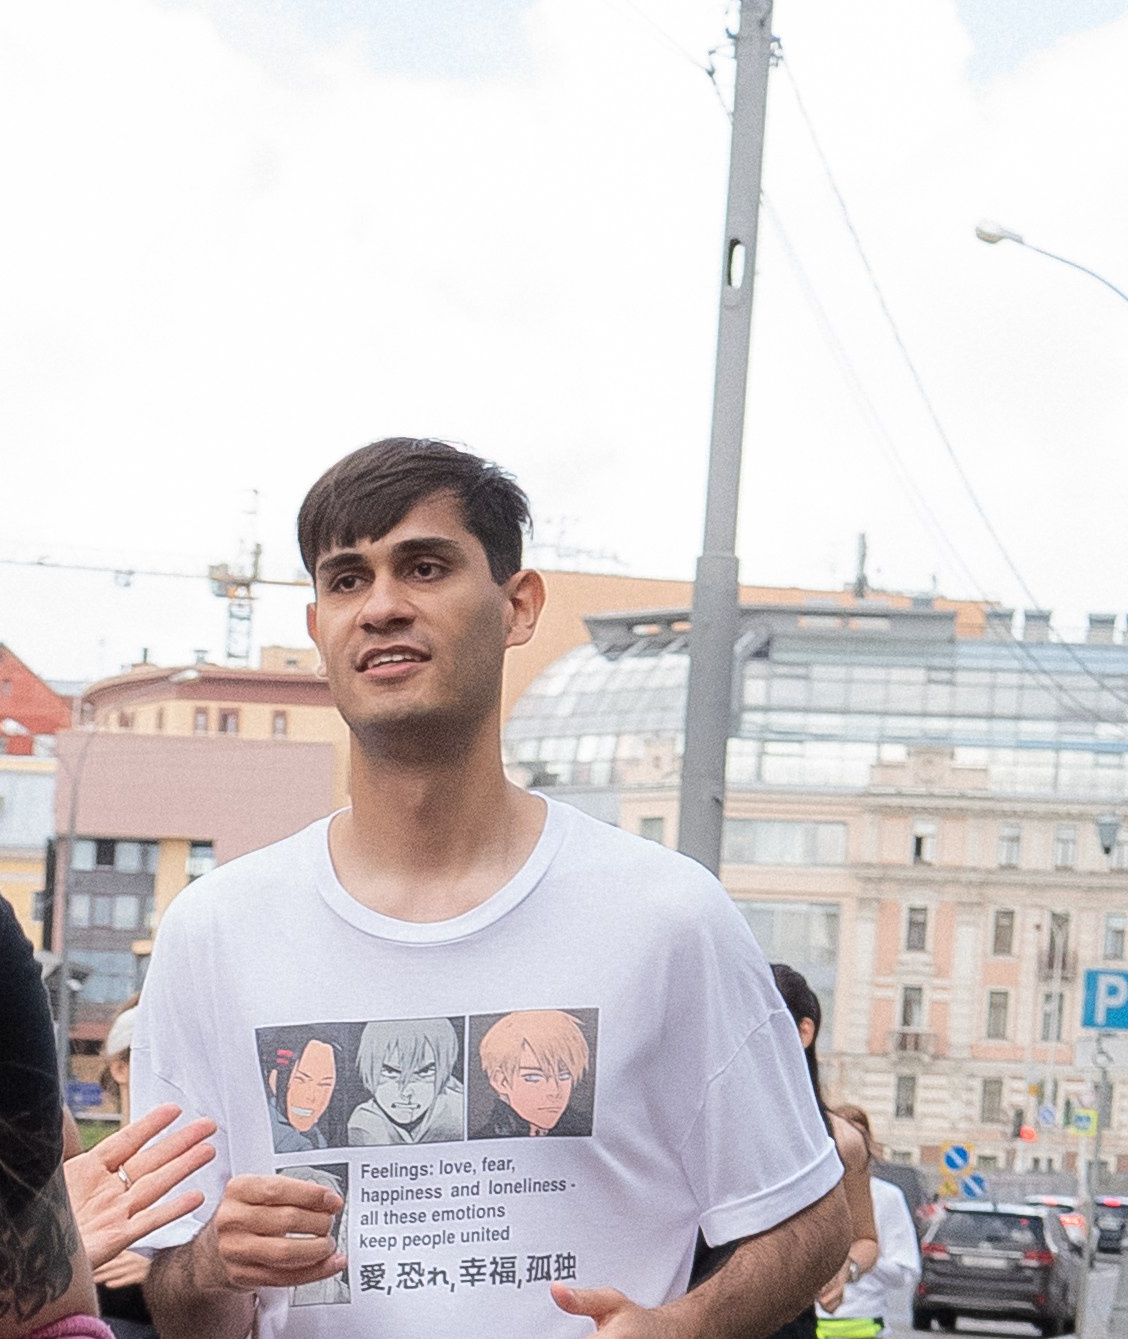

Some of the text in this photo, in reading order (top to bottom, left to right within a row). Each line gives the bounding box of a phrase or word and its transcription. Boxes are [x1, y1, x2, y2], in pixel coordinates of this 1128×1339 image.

[1094, 974, 1128, 1025] P
[360, 1157, 516, 1181] Feelings: love, fear,
[360, 1187, 443, 1205] happiness
[450, 1181, 480, 1199] and
[488, 1177, 567, 1195] loneliness
[360, 1204, 506, 1226] all these emotions
[359, 1225, 510, 1250] keep people united
